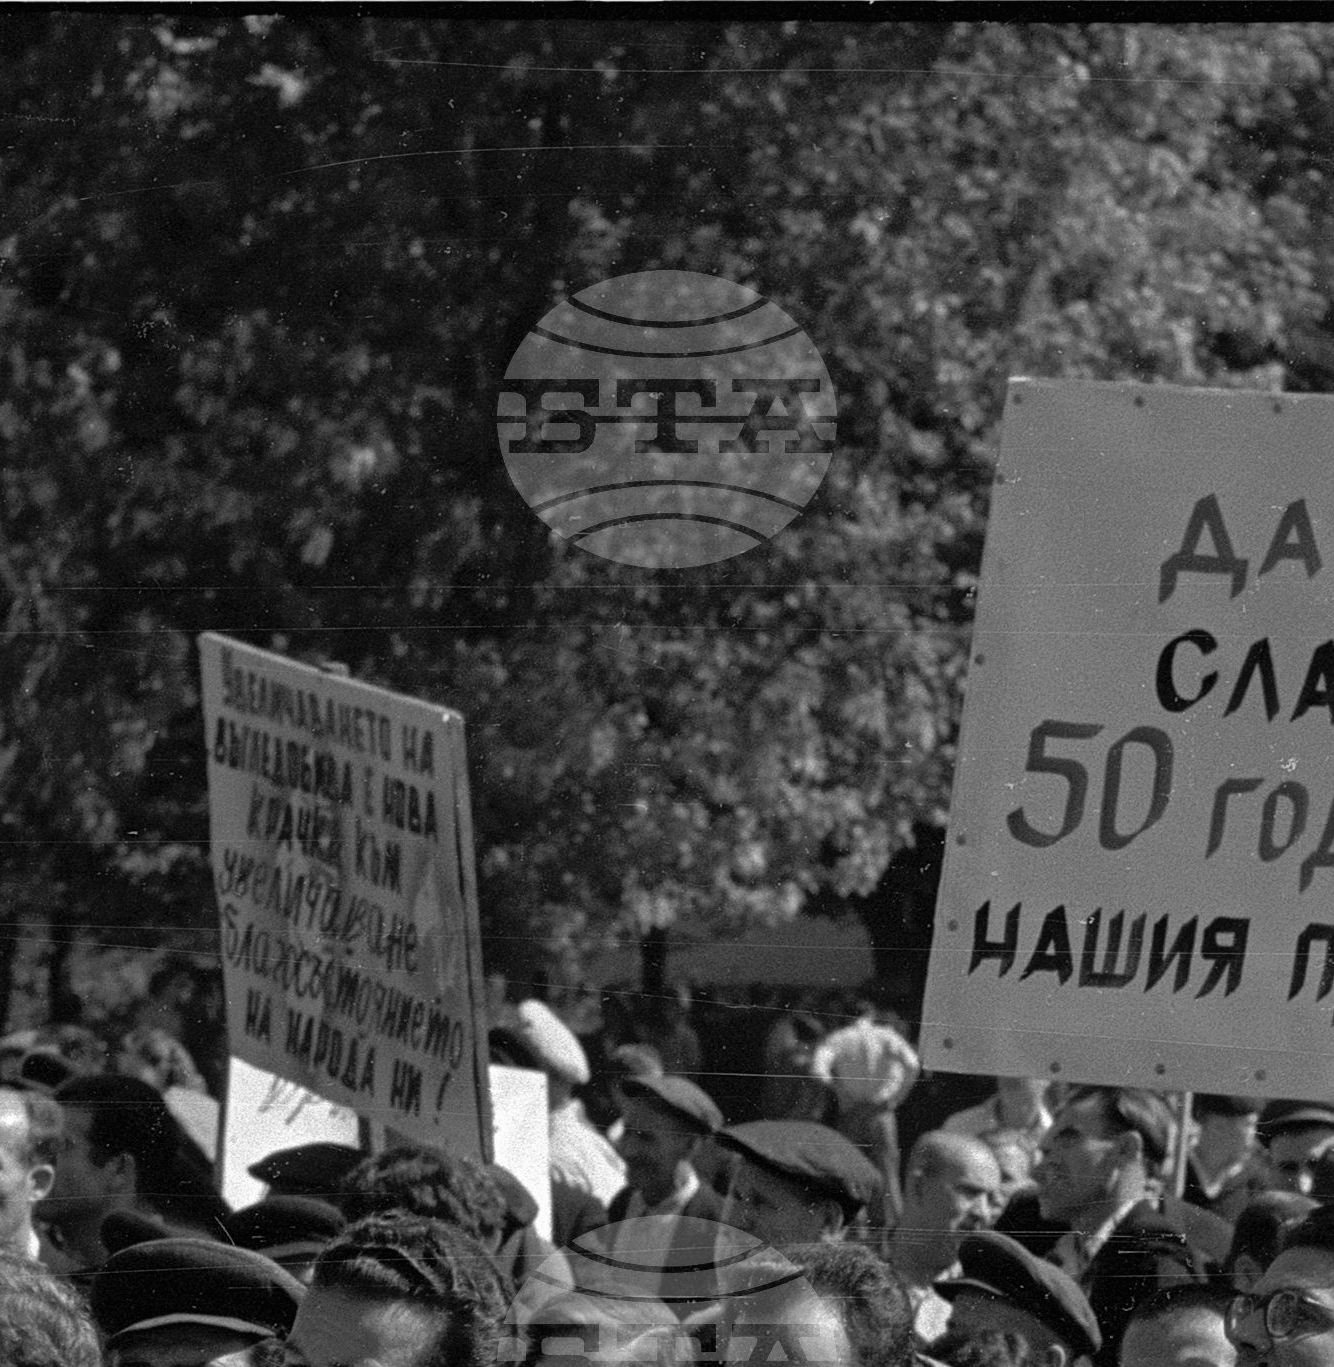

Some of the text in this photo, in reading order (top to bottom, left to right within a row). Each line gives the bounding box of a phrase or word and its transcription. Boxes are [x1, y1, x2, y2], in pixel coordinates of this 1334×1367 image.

[1159, 492, 1324, 604] ДА
[401, 724, 434, 777] НА
[1006, 719, 1175, 851] 50
[382, 776, 438, 841] НОВА
[968, 899, 1252, 1000] НАШИЯ
[245, 987, 271, 1044] НА
[286, 1007, 376, 1097] НАРОДА
